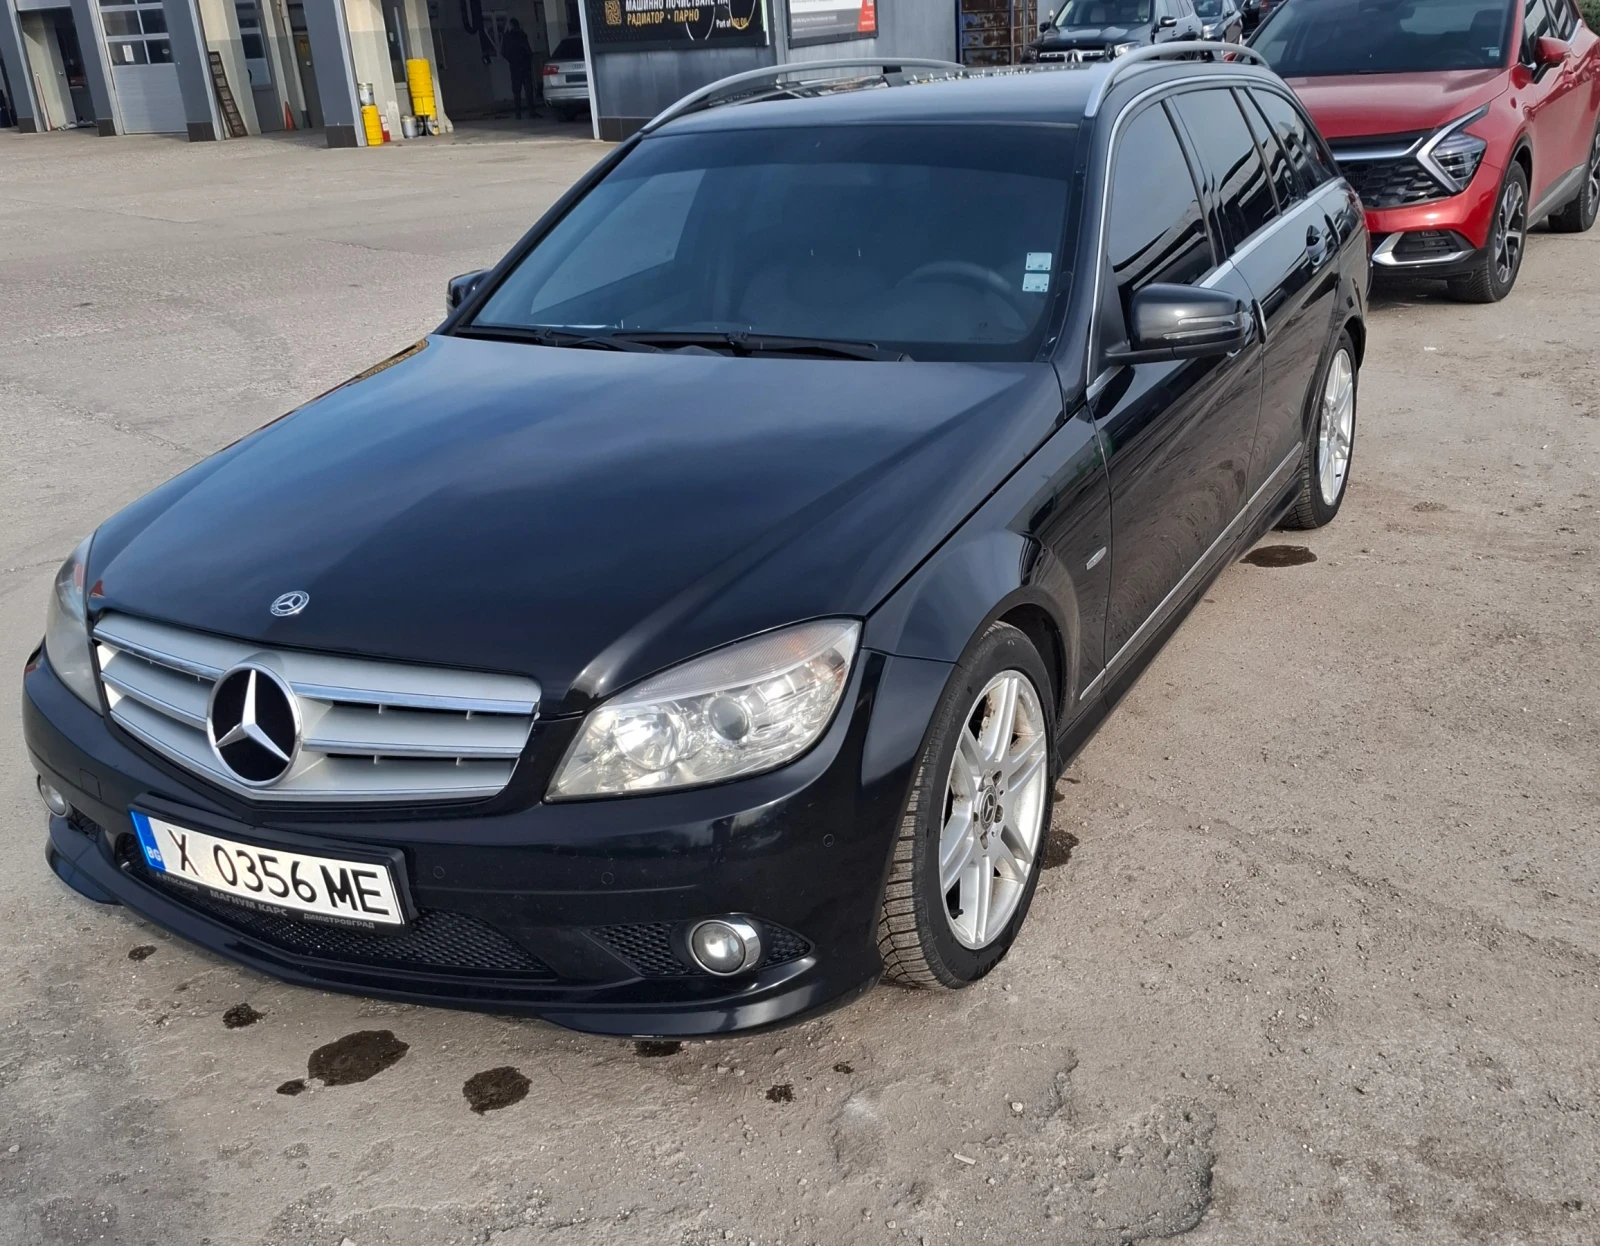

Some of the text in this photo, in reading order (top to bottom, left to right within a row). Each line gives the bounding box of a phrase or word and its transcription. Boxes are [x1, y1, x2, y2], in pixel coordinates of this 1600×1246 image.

[627, 9, 699, 27] РАДИАТОР ПАРНО
[146, 845, 161, 861] BG
[213, 844, 317, 902] 0356
[319, 864, 390, 915] ME
[210, 889, 256, 910] МАГНУМ
[258, 902, 288, 917] КАРС
[304, 913, 375, 929] ДИМИТРОВГРАД
